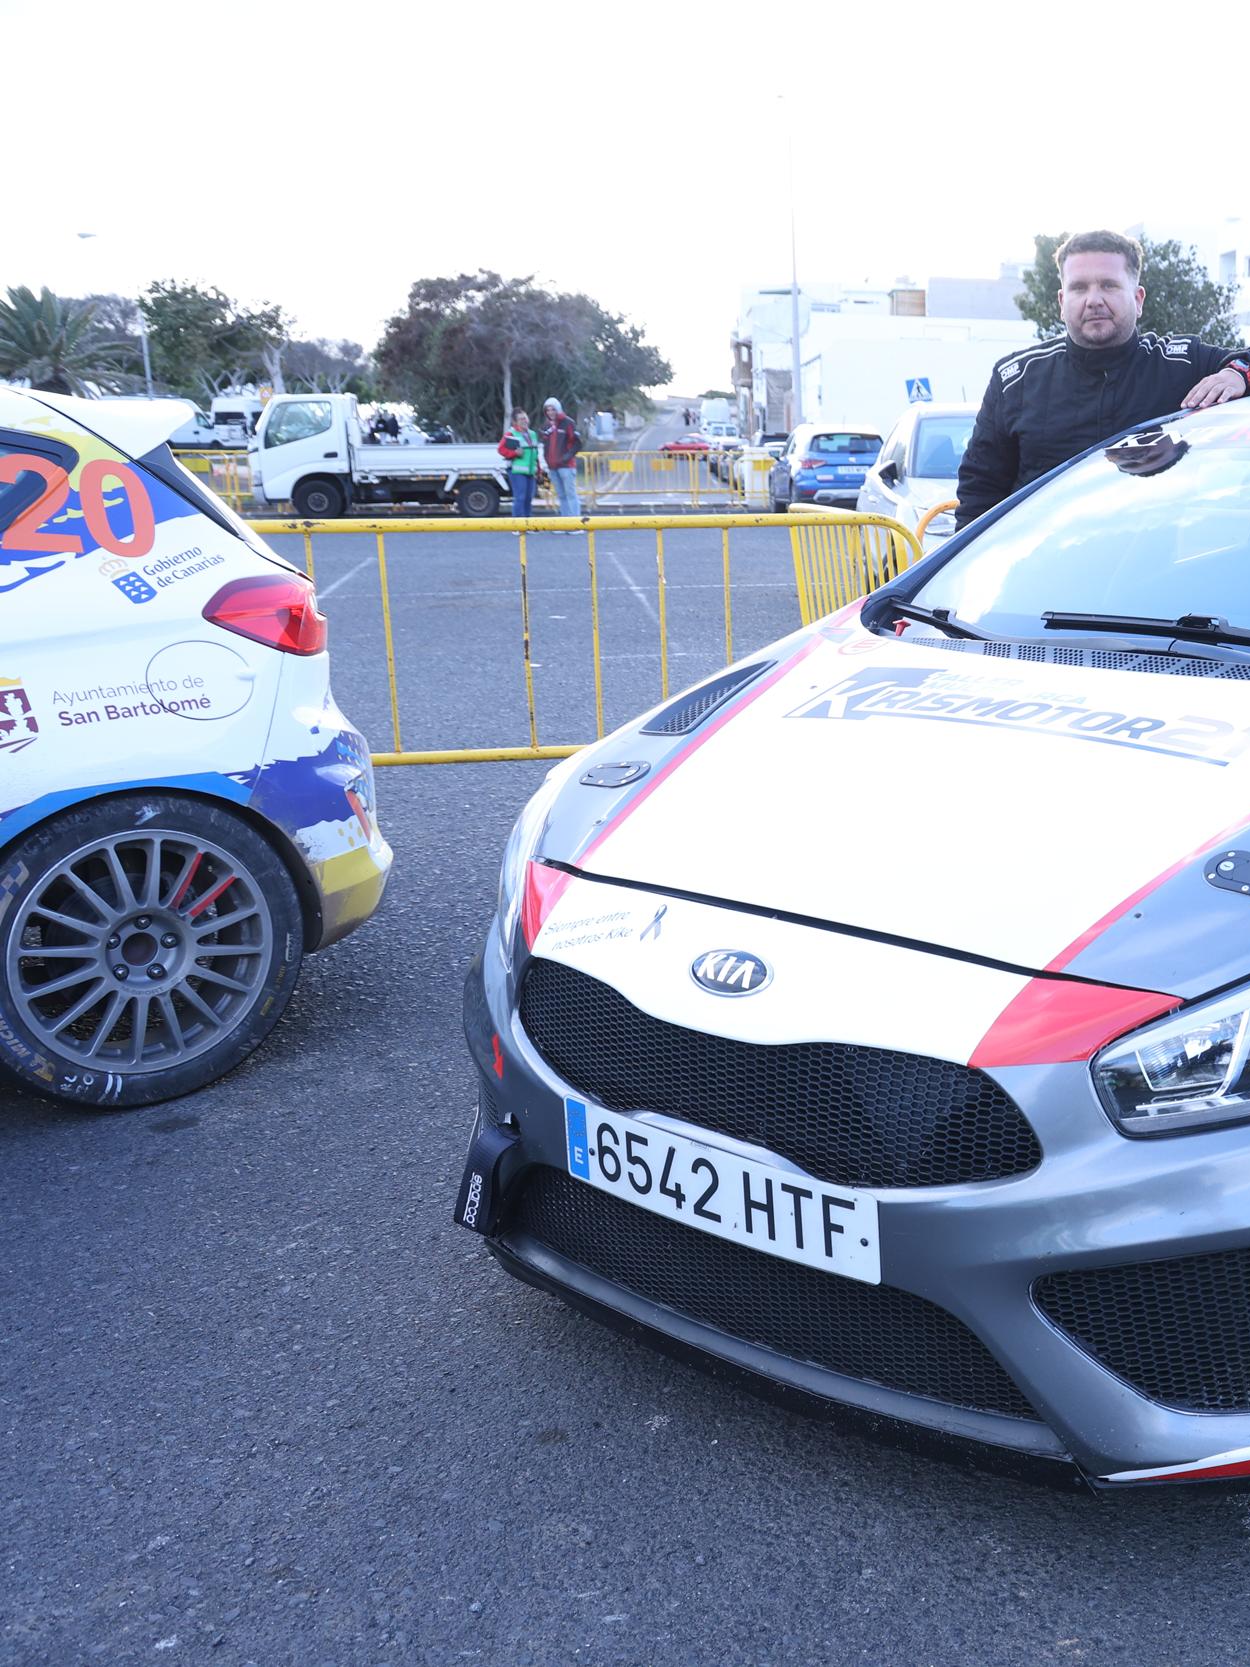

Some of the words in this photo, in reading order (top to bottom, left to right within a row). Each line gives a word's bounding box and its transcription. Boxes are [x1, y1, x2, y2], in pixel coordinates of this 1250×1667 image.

[1165, 344, 1188, 356] OMP
[1001, 365, 1020, 380] OMP
[0, 453, 155, 558] 20
[143, 546, 202, 576] Gobierno
[157, 576, 175, 588] de
[171, 554, 225, 580] Canarias
[52, 680, 178, 707] Ayuntamiento
[182, 675, 204, 689] de
[58, 710, 101, 727] San
[104, 692, 211, 720] Bartolomé
[544, 917, 595, 936] Siempre
[596, 911, 631, 925] entre
[551, 932, 604, 951] nosotros
[605, 926, 633, 940] Kike
[697, 952, 755, 989] KIA
[466, 1174, 483, 1224] sparco
[575, 1148, 584, 1165] E
[596, 1122, 722, 1223] 6542
[742, 1170, 856, 1258] HTF
